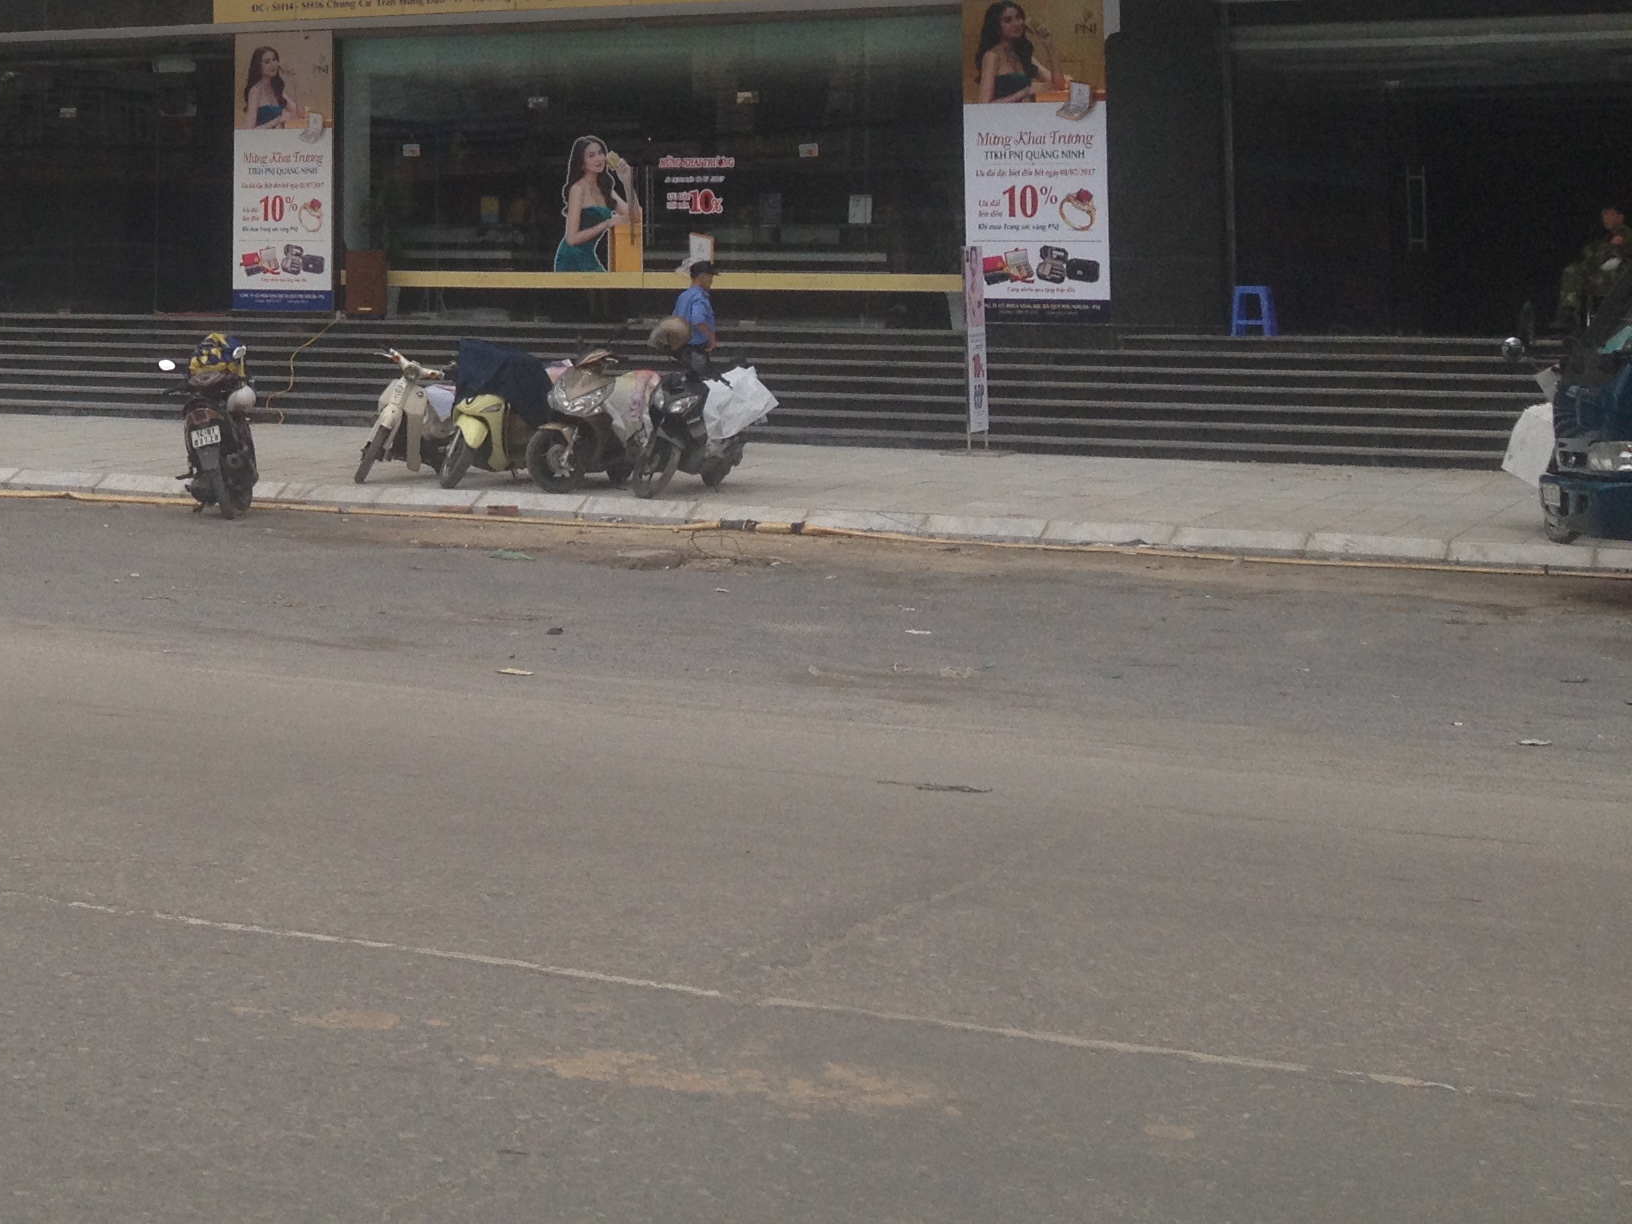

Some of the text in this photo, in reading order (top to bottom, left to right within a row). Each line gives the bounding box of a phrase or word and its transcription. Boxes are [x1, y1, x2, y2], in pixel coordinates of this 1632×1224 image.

[976, 131, 1012, 151] Mừng
[1014, 130, 1047, 146] Khai
[1061, 149, 1085, 160] NINH
